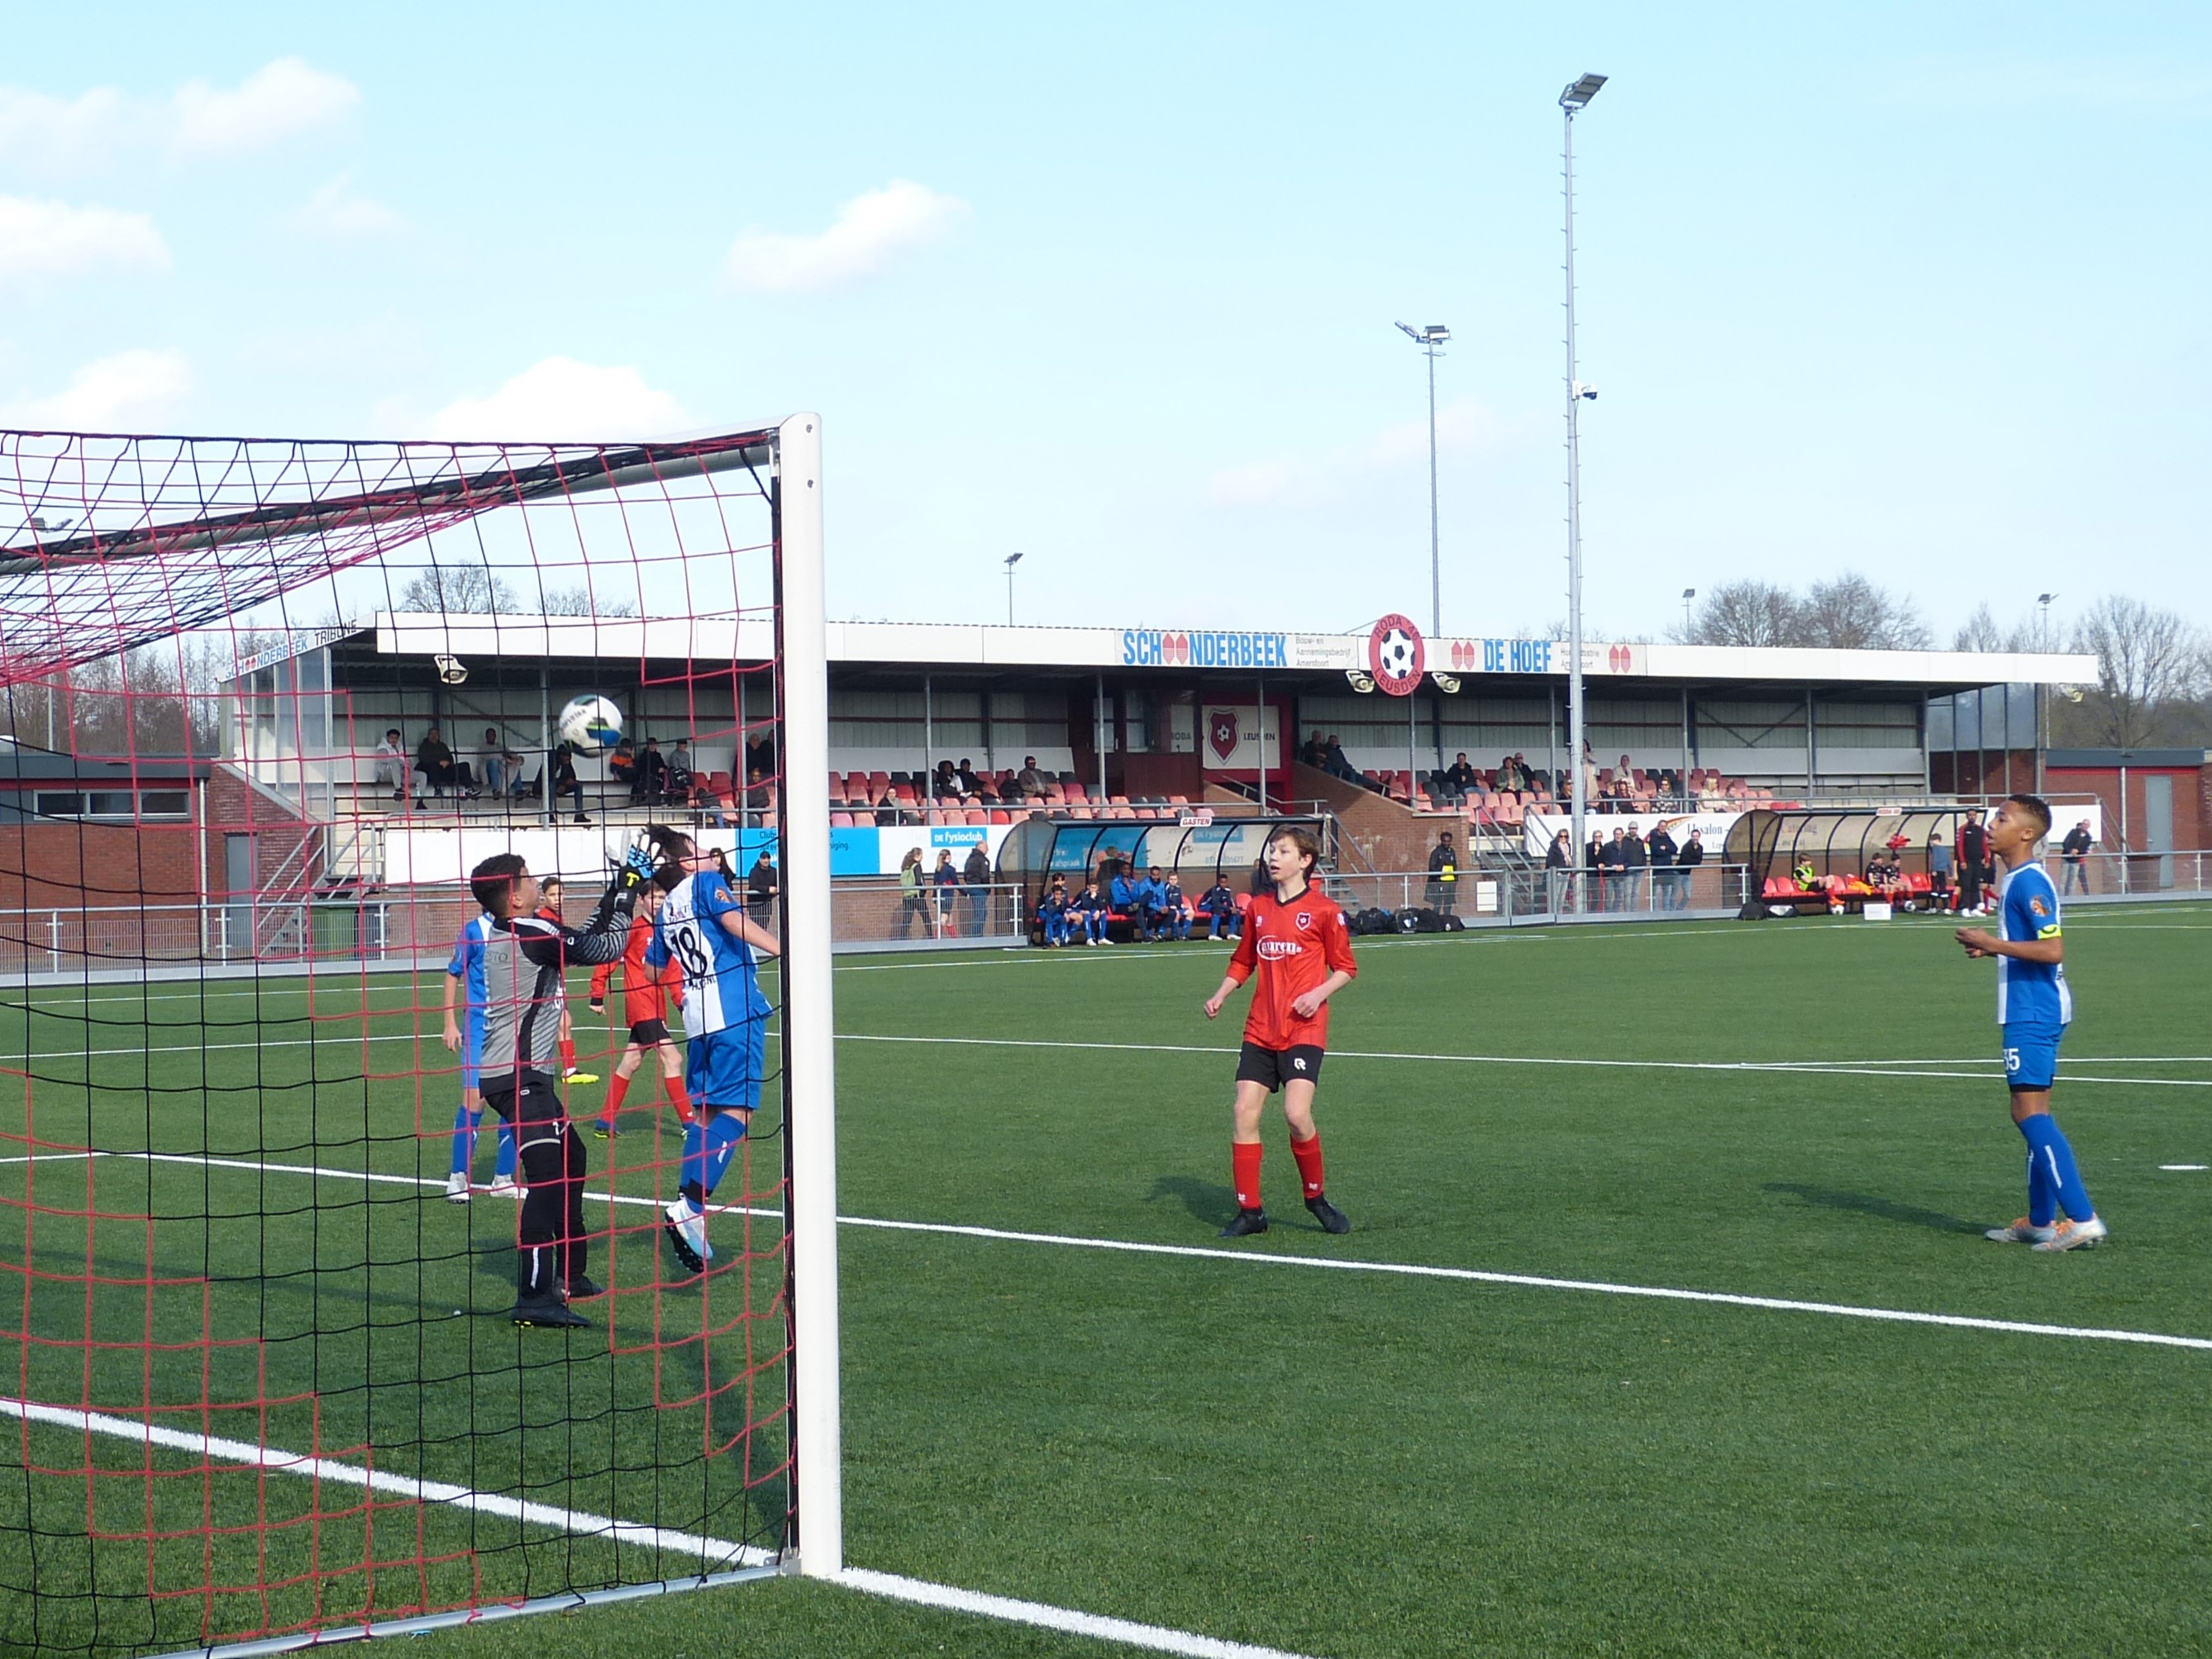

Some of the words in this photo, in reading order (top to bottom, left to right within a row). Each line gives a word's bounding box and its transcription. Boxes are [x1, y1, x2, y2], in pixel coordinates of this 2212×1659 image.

[314, 618, 358, 646] TRIBUNE
[1374, 615, 1403, 638] RODA
[1484, 639, 1505, 671] DE
[1509, 640, 1552, 672] HOEF
[1374, 667, 1421, 694] LEUSDEN
[1243, 732, 1275, 741] LEUSEN
[934, 834, 944, 842] DE
[945, 832, 983, 844] fysioclub
[670, 927, 708, 986] 18
